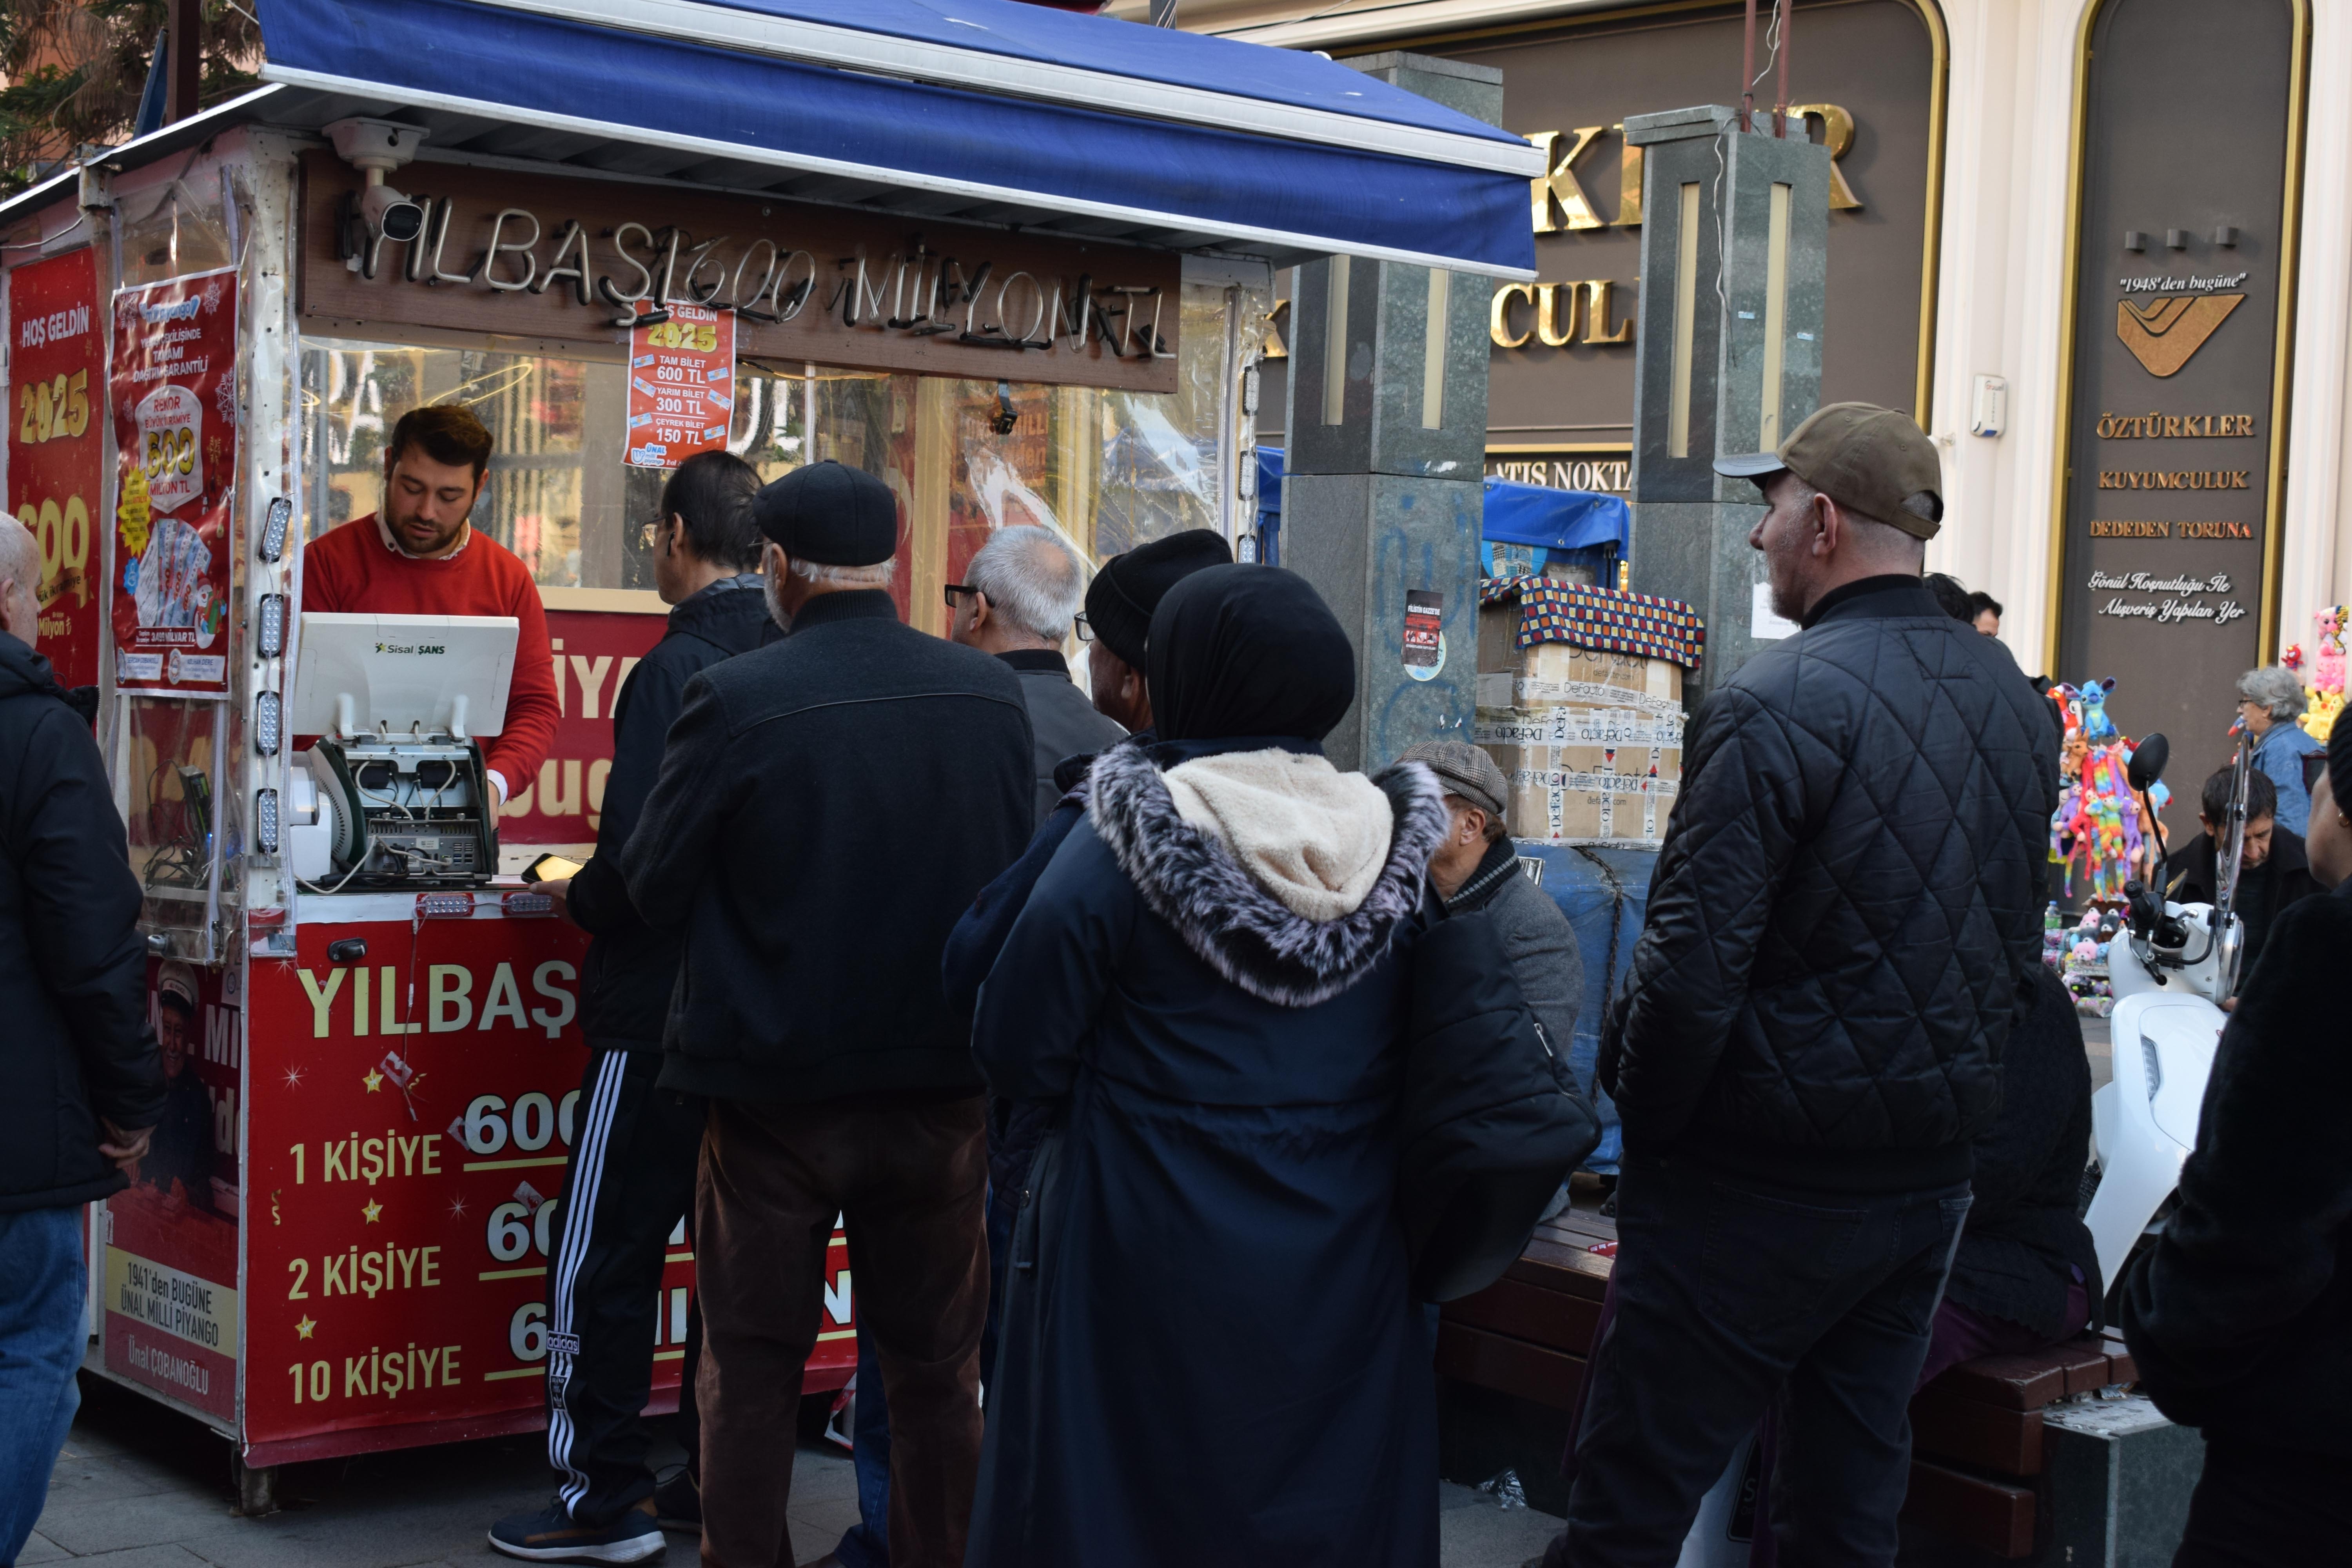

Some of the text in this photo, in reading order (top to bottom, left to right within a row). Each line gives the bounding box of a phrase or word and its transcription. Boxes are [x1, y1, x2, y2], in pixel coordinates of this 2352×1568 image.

[684, 235, 815, 323] 600
[677, 306, 717, 322] GELDİN
[23, 301, 89, 348] HOŞ GELDİN
[648, 322, 717, 353] 2025
[153, 346, 183, 363] TAMAMI
[659, 355, 706, 368] TAM BİLET
[163, 355, 209, 377] GARANTİLİ
[657, 365, 706, 385] 600 TL
[657, 387, 705, 399] YARIM BİLET
[20, 367, 89, 444] 2025
[154, 396, 181, 412] REKOR
[656, 397, 705, 415] 300 TL
[145, 416, 163, 428] BÜYÜK
[656, 418, 705, 429] ÇEYREK BİLET
[2097, 411, 2255, 439] ÖZTÜRKLER
[657, 427, 702, 445] 150 TL
[147, 427, 195, 479] 600
[647, 444, 665, 454] ÜNAL
[180, 480, 191, 493] TL
[2098, 470, 2249, 490] KUYUMCULUK
[2089, 520, 2252, 539] DEDEDEN TORUNA
[2088, 570, 2130, 591] Gönül
[2129, 572, 2206, 597] Hoşnutluğu
[2098, 598, 2246, 624] Alışveriş Yapılan Yer
[38, 616, 65, 639] Milyon
[188, 632, 196, 641] TL
[388, 645, 445, 655] Sisal ŞANS
[1564, 682, 1604, 696] DeFacto
[1639, 693, 1674, 710] DeFacto
[290, 1143, 305, 1185] 1
[324, 1129, 442, 1185] KİŞİYE
[288, 1258, 309, 1300] 2
[323, 1241, 441, 1299] KİŞİYE
[128, 1261, 212, 1315] 1941'den BUGÜNE
[121, 1284, 218, 1347] ÜNAL MİLLİ PİYANGO
[548, 1335, 578, 1352] adidas
[129, 1334, 209, 1395] Ünal ÇOBANOĞLU
[289, 1360, 331, 1405] 10
[345, 1342, 462, 1399] KİŞİYE
